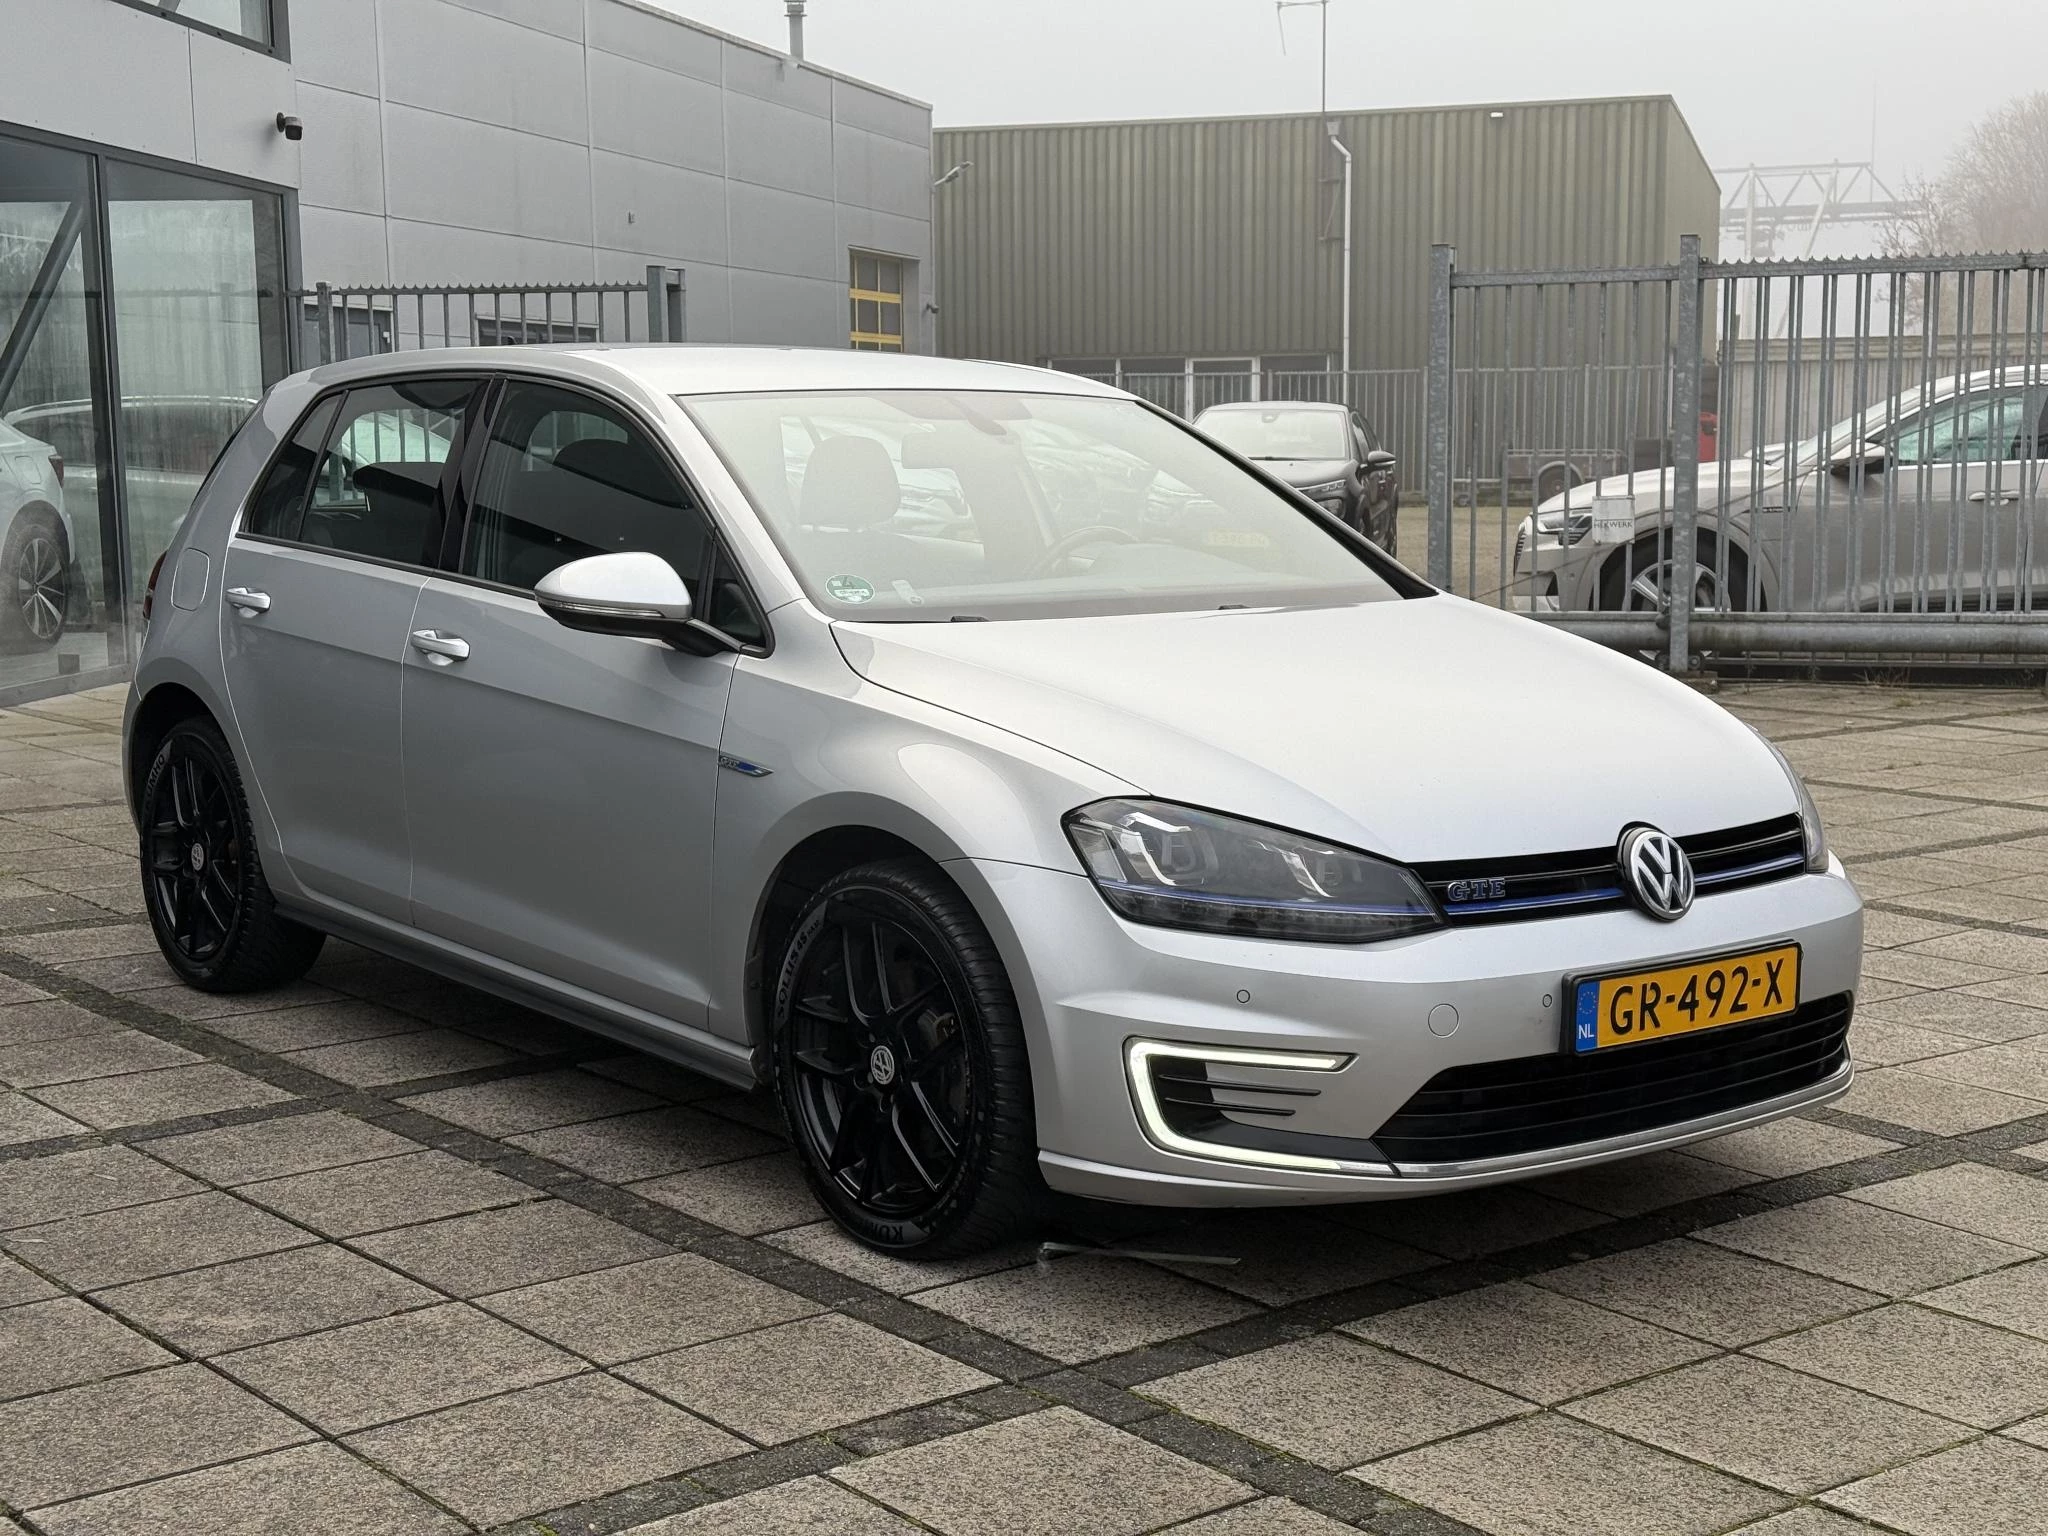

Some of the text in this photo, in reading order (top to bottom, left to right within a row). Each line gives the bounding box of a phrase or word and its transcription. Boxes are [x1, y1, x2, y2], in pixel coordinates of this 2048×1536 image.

[1448, 877, 1505, 901] GTE
[1609, 958, 1784, 1035] GR-492-X
[1578, 1024, 1594, 1039] NL
